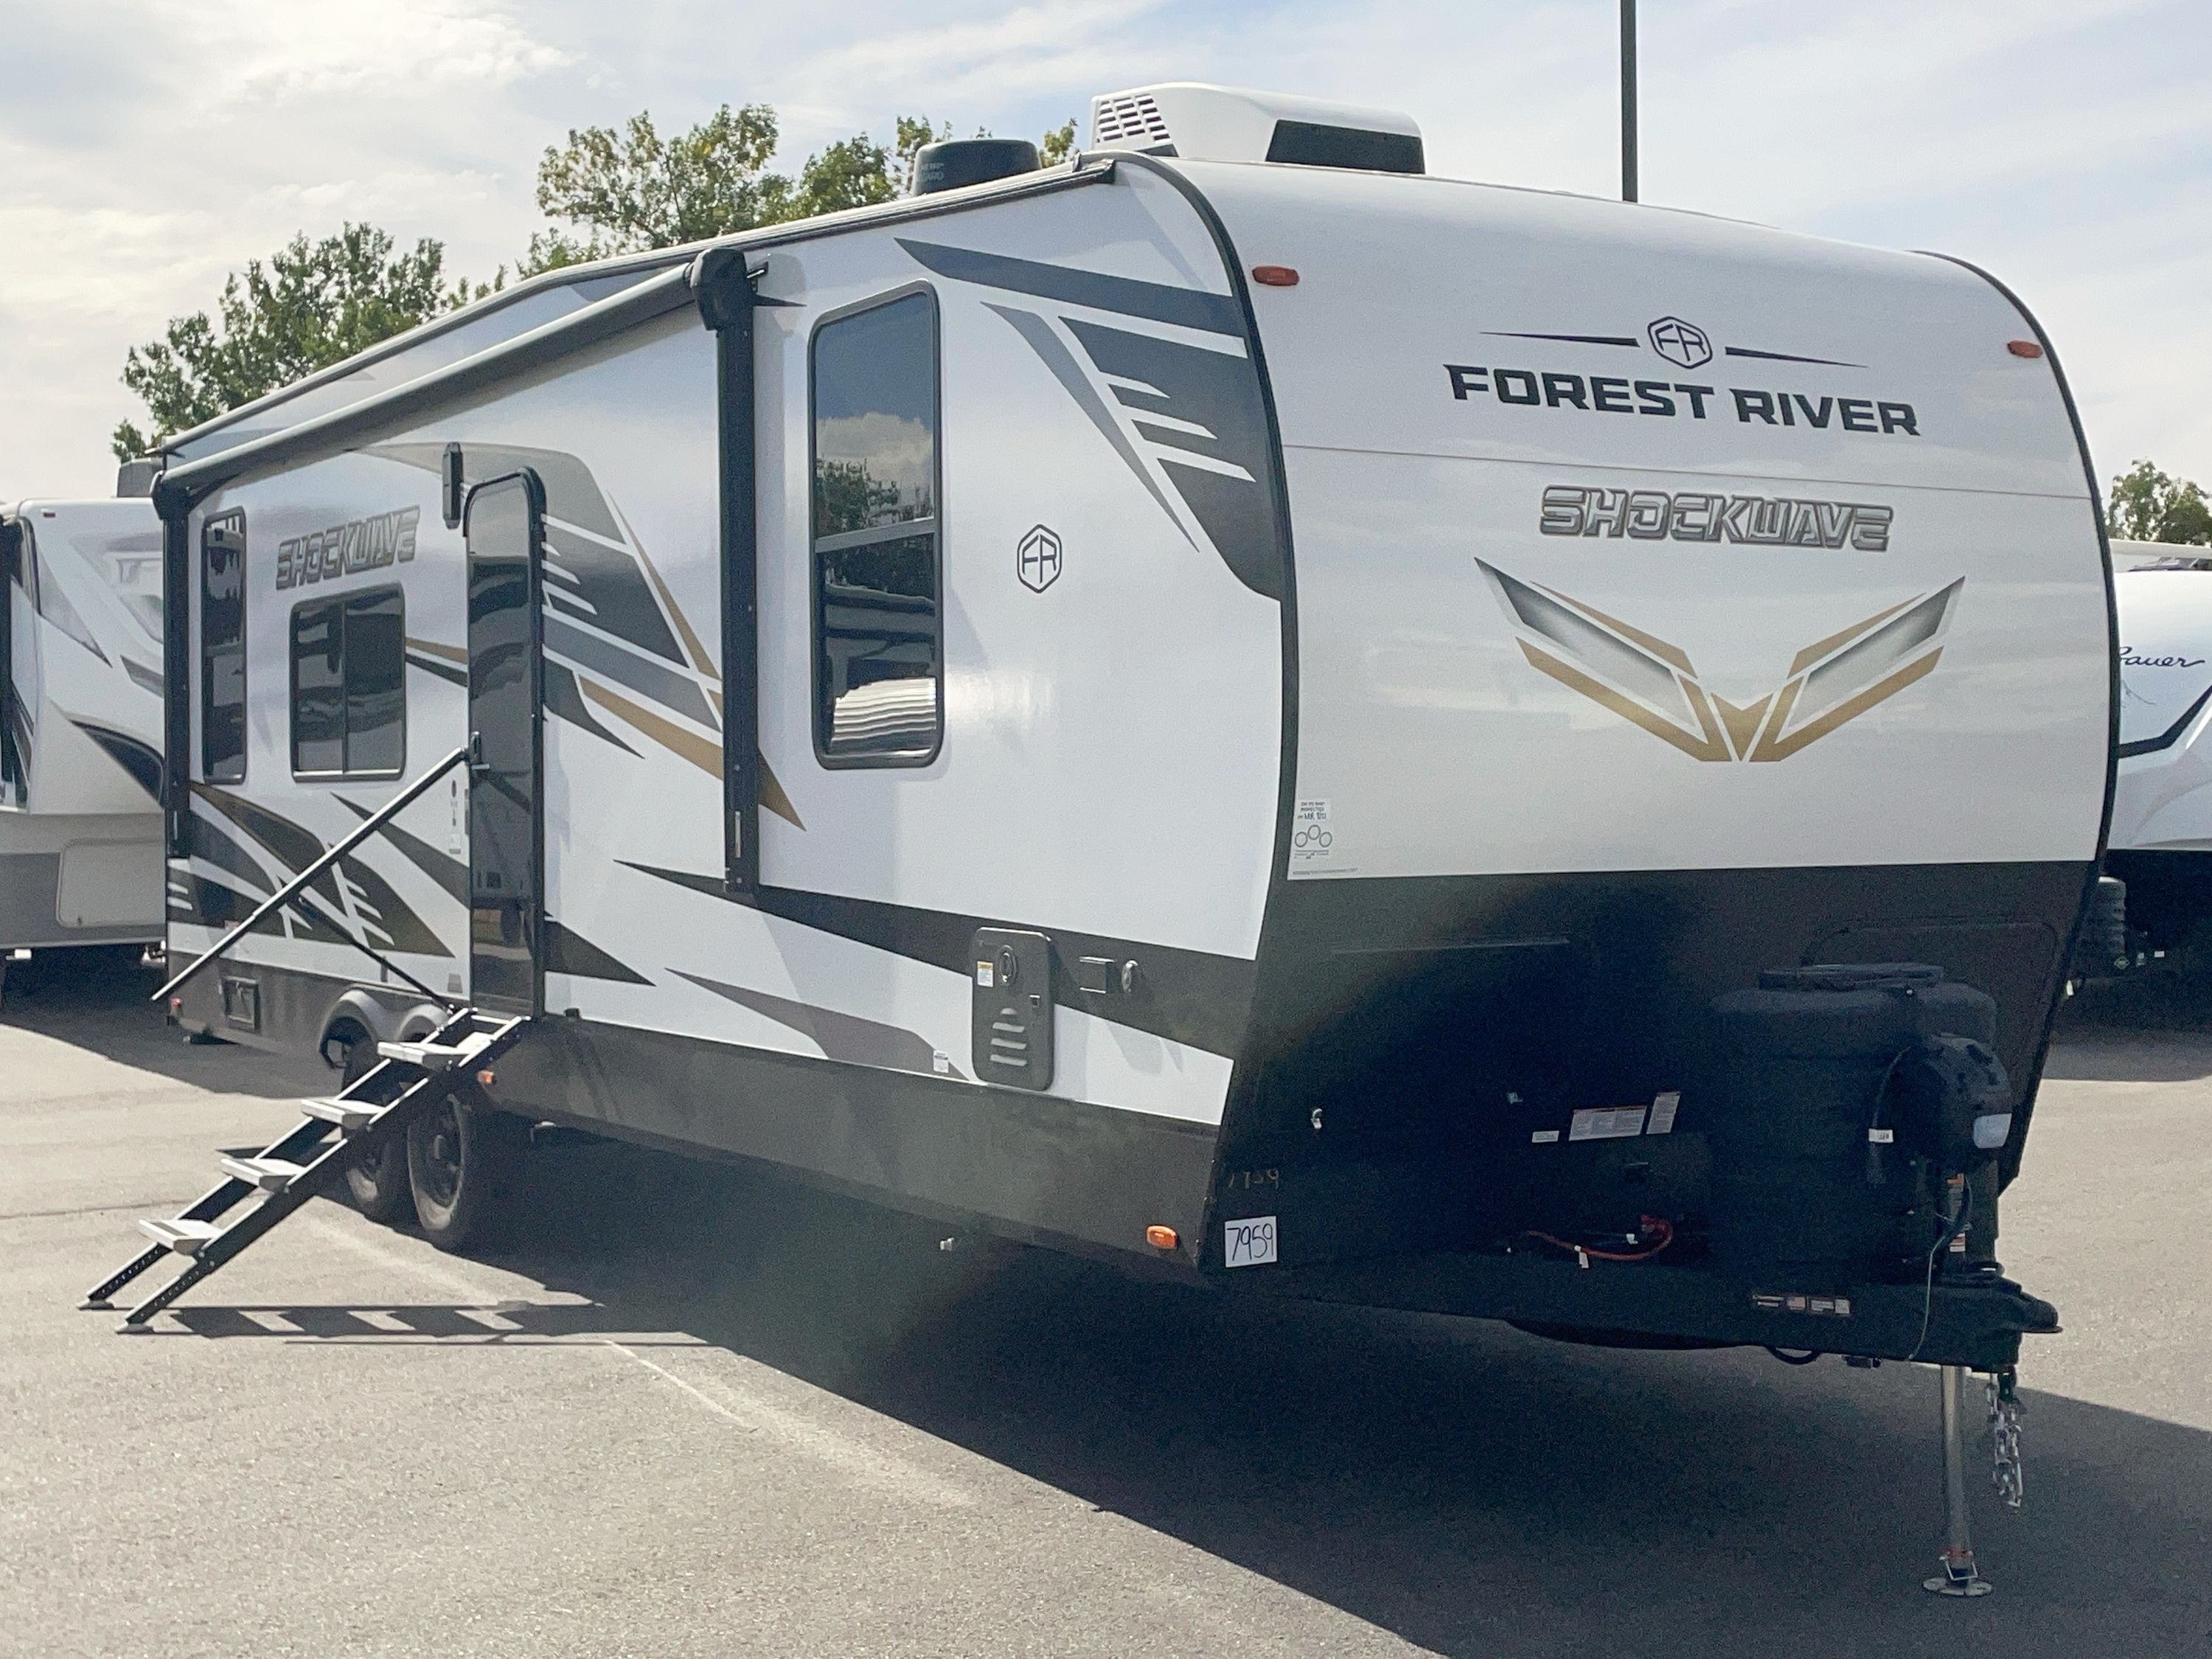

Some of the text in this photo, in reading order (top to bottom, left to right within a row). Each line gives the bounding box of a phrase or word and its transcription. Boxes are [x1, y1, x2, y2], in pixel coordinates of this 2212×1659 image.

[1443, 364, 1921, 437] FOREST RIVER
[276, 504, 420, 590] SHOCKWAVE
[1540, 484, 1893, 552] SHOCKWAVE
[1226, 1223, 1274, 1261] 7959
